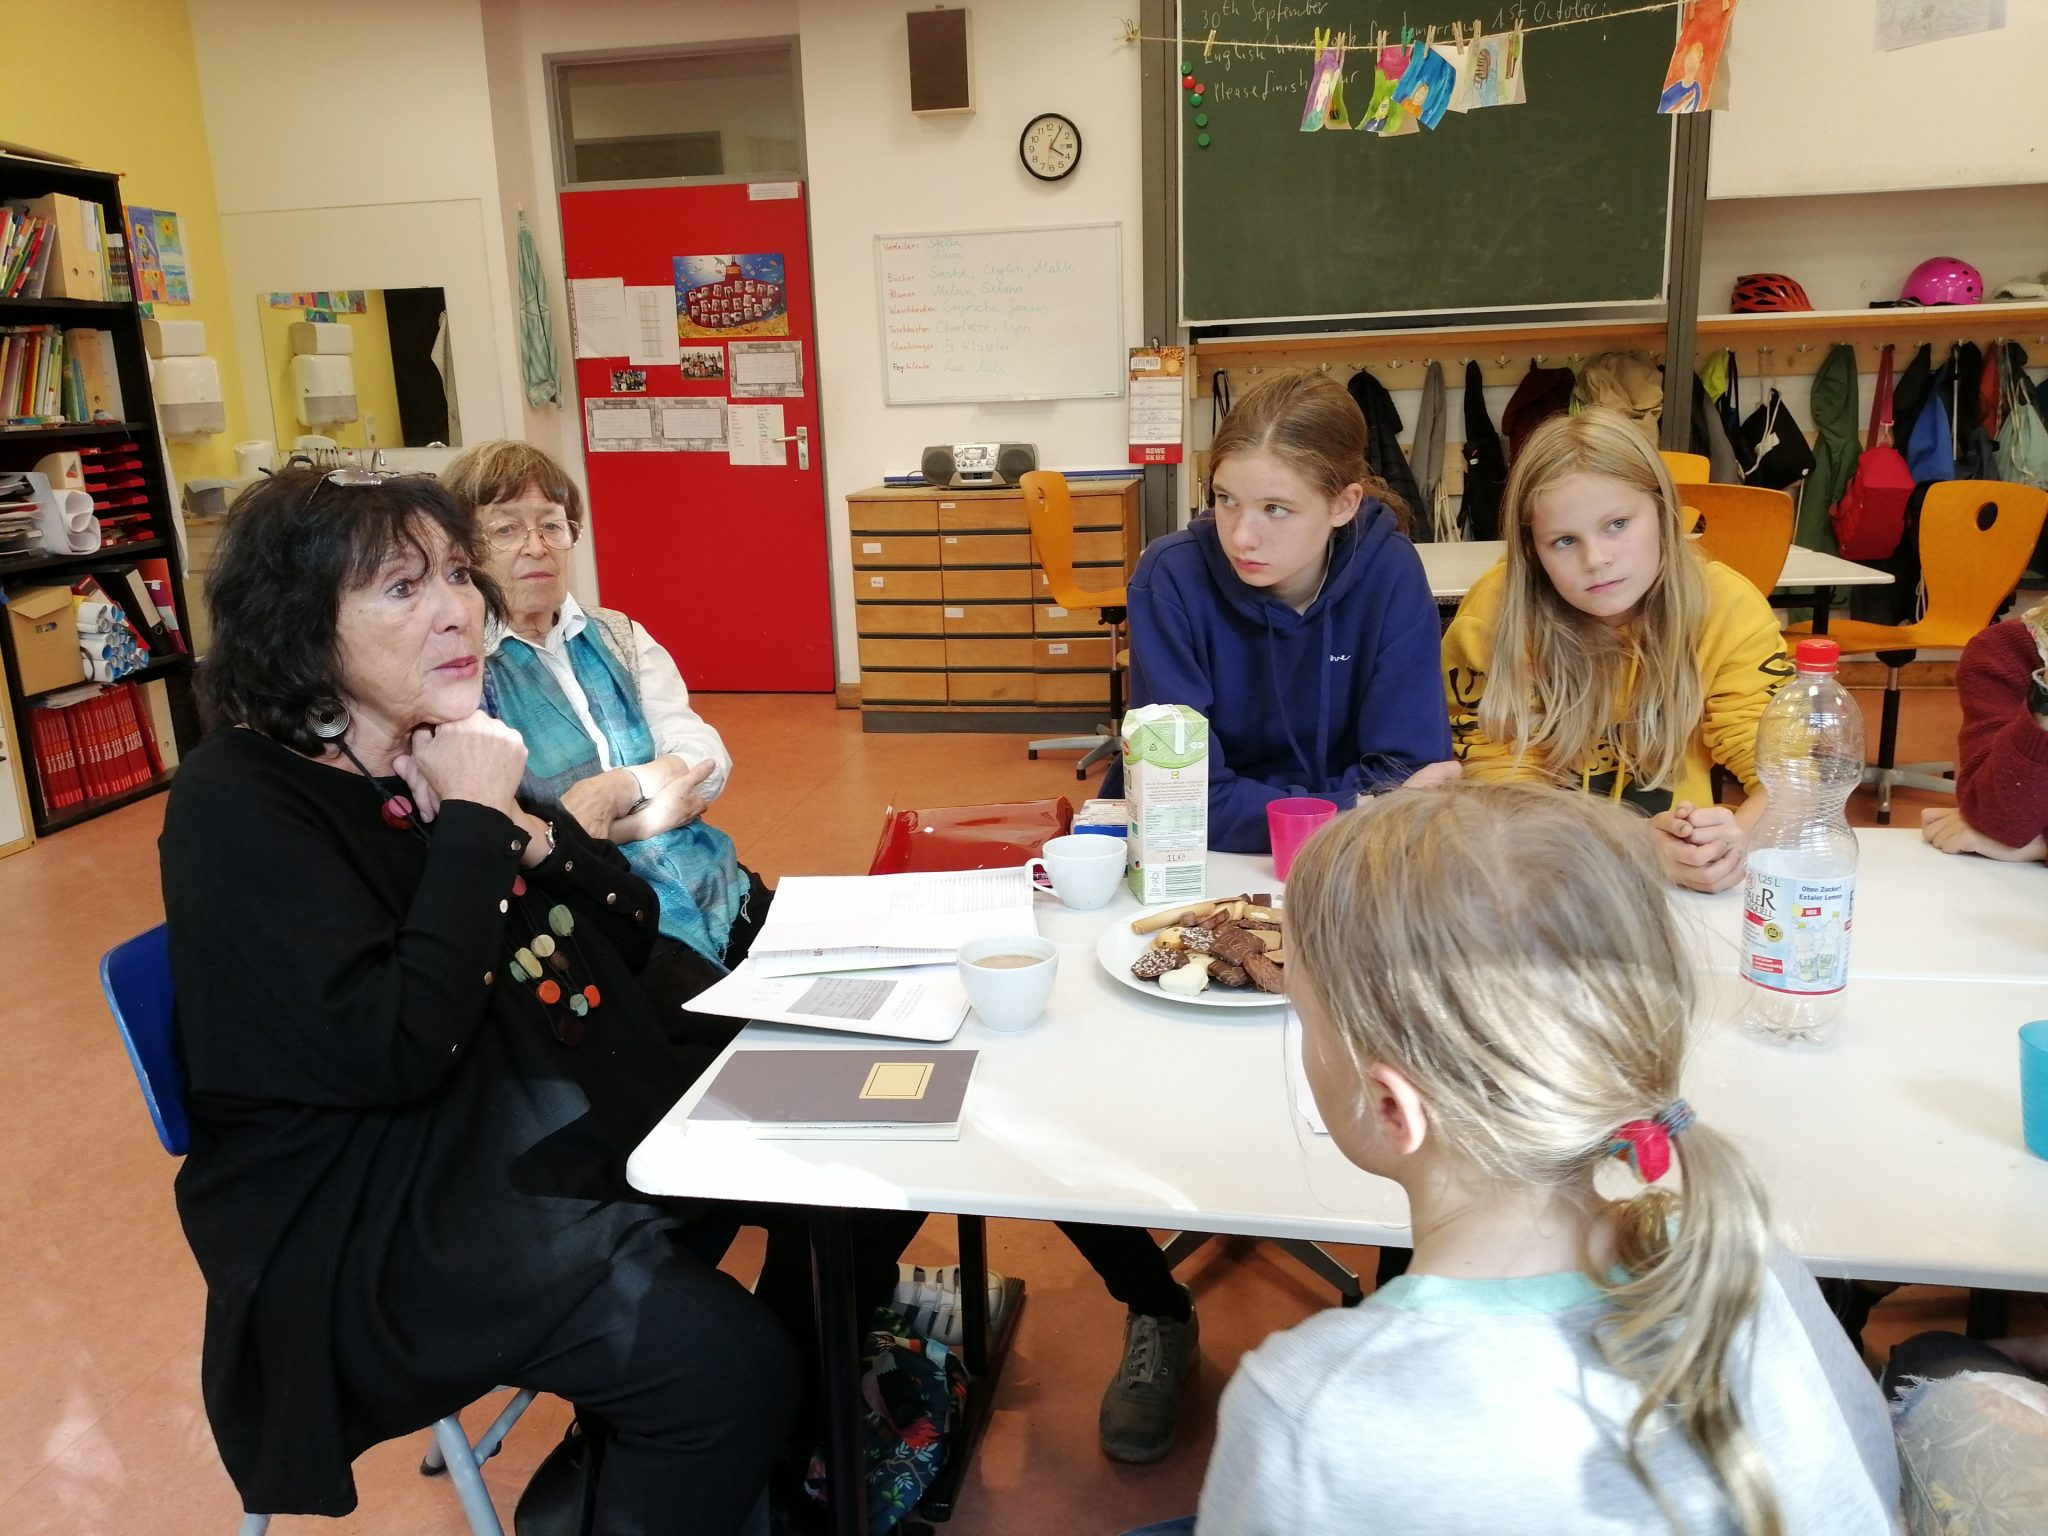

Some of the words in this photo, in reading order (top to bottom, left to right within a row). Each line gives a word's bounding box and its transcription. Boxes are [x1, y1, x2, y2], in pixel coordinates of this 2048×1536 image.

[1251, 0, 1329, 31] September
[1037, 127, 1044, 135] 11
[1046, 123, 1054, 131] 12
[1031, 135, 1039, 143] 10
[1064, 132, 1070, 140] 2
[1028, 145, 1035, 153] 9
[1032, 155, 1038, 163] 8
[1064, 152, 1071, 160] 4
[1048, 164, 1055, 172] 6
[1058, 161, 1064, 169] 5
[1132, 358, 1159, 368] SEPTEMBER
[1145, 447, 1166, 455] REWE
[1820, 884, 1842, 893] Zucker!
[1799, 893, 1823, 901] Extaler
